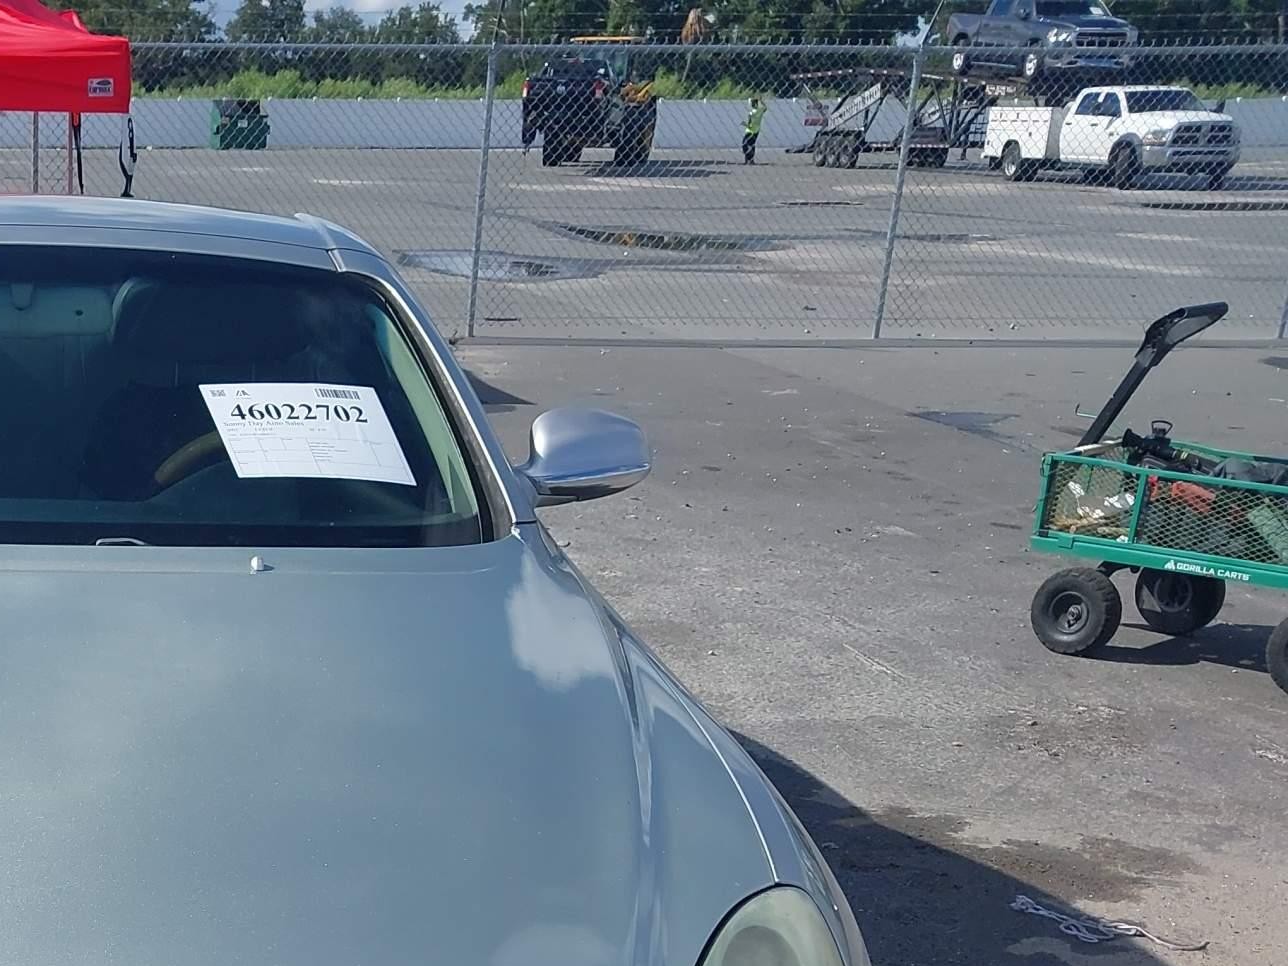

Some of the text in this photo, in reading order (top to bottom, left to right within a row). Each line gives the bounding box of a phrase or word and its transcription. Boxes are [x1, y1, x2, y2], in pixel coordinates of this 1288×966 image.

[230, 403, 368, 424] 46022702
[1176, 562, 1250, 581] GORILLA CARTS
